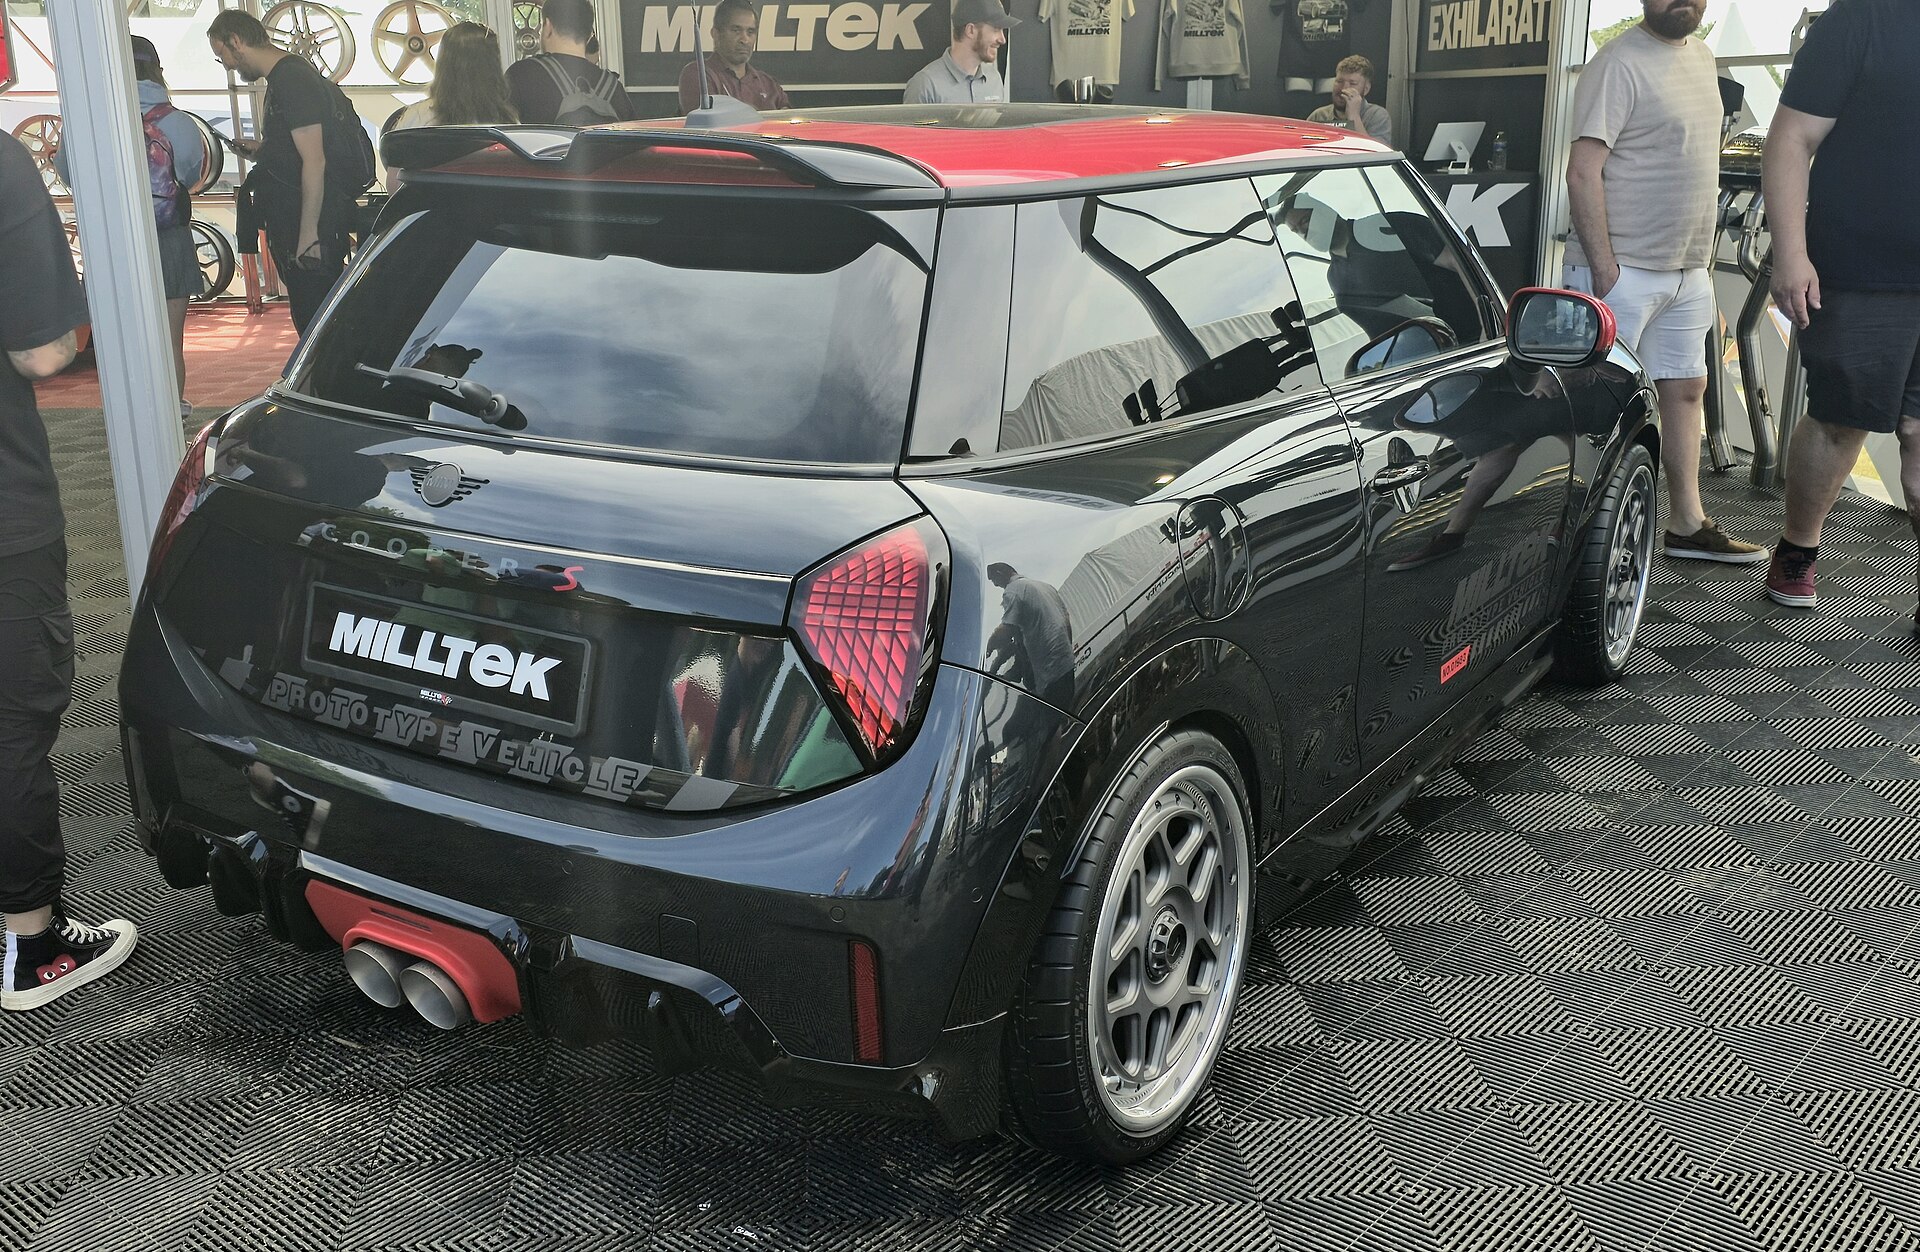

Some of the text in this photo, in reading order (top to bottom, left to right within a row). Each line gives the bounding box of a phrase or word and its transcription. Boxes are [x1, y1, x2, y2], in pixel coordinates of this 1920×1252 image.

[640, 1, 931, 53] MILTeK
[1427, 0, 1551, 51] EXHILARAT
[321, 523, 584, 592] COOPER S
[269, 676, 462, 753] PROTOTYPE
[473, 728, 640, 796] VEHICLE
